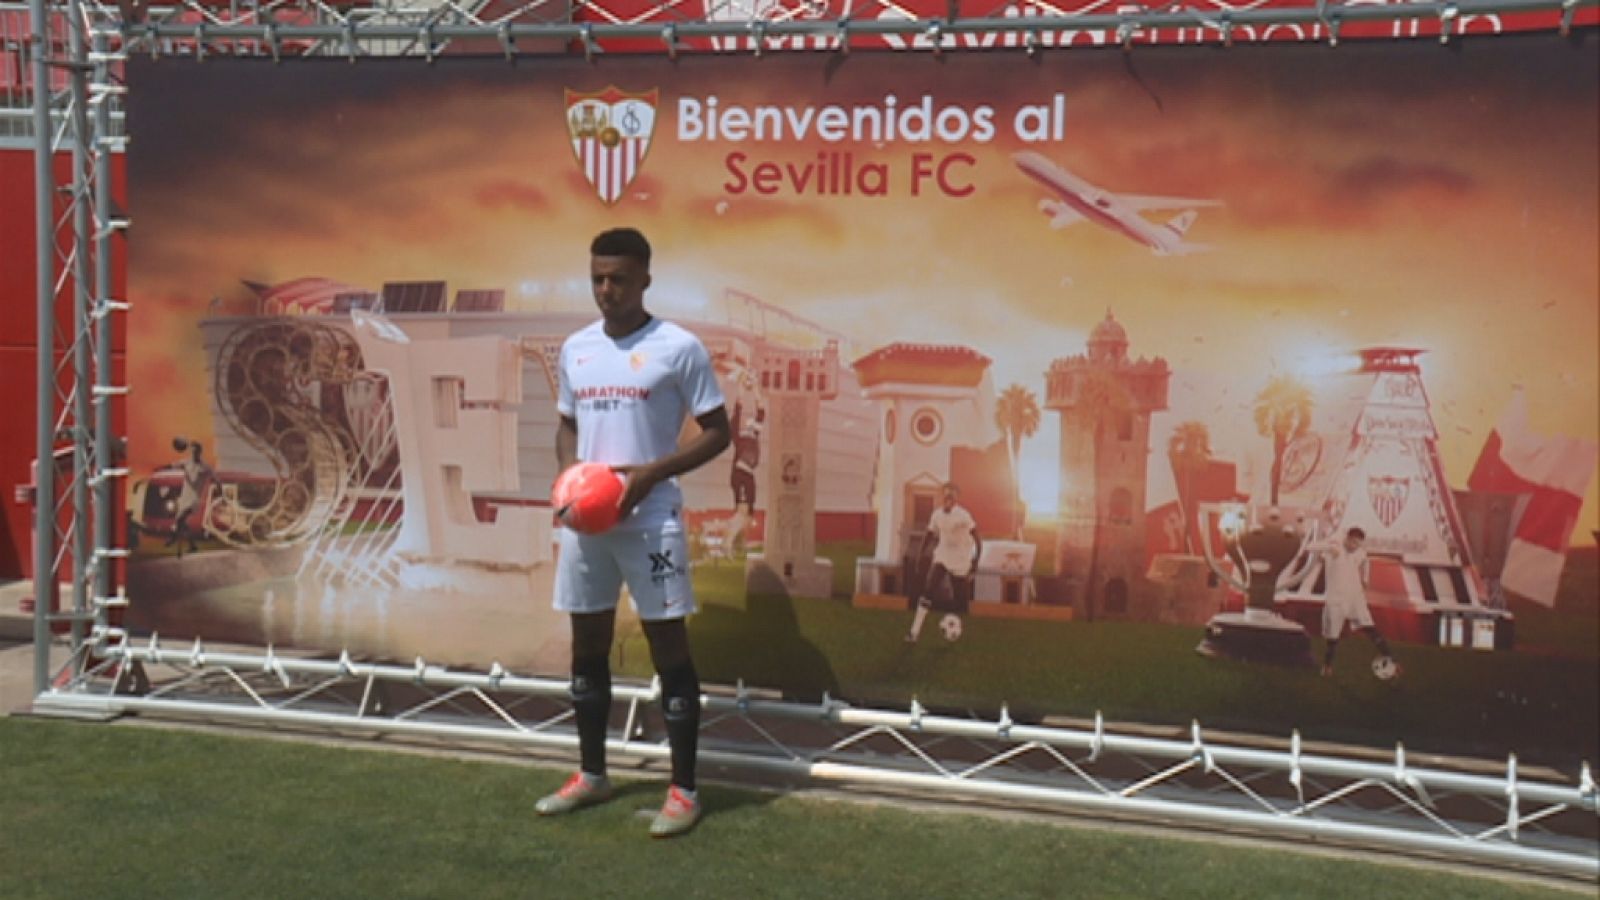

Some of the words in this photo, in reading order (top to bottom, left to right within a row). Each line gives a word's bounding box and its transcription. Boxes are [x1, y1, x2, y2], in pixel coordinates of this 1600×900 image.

[677, 94, 996, 142] Bienvenidos
[1014, 92, 1066, 142] al
[724, 151, 888, 196] Sevilla
[911, 152, 976, 198] FC
[593, 399, 620, 412] BET
